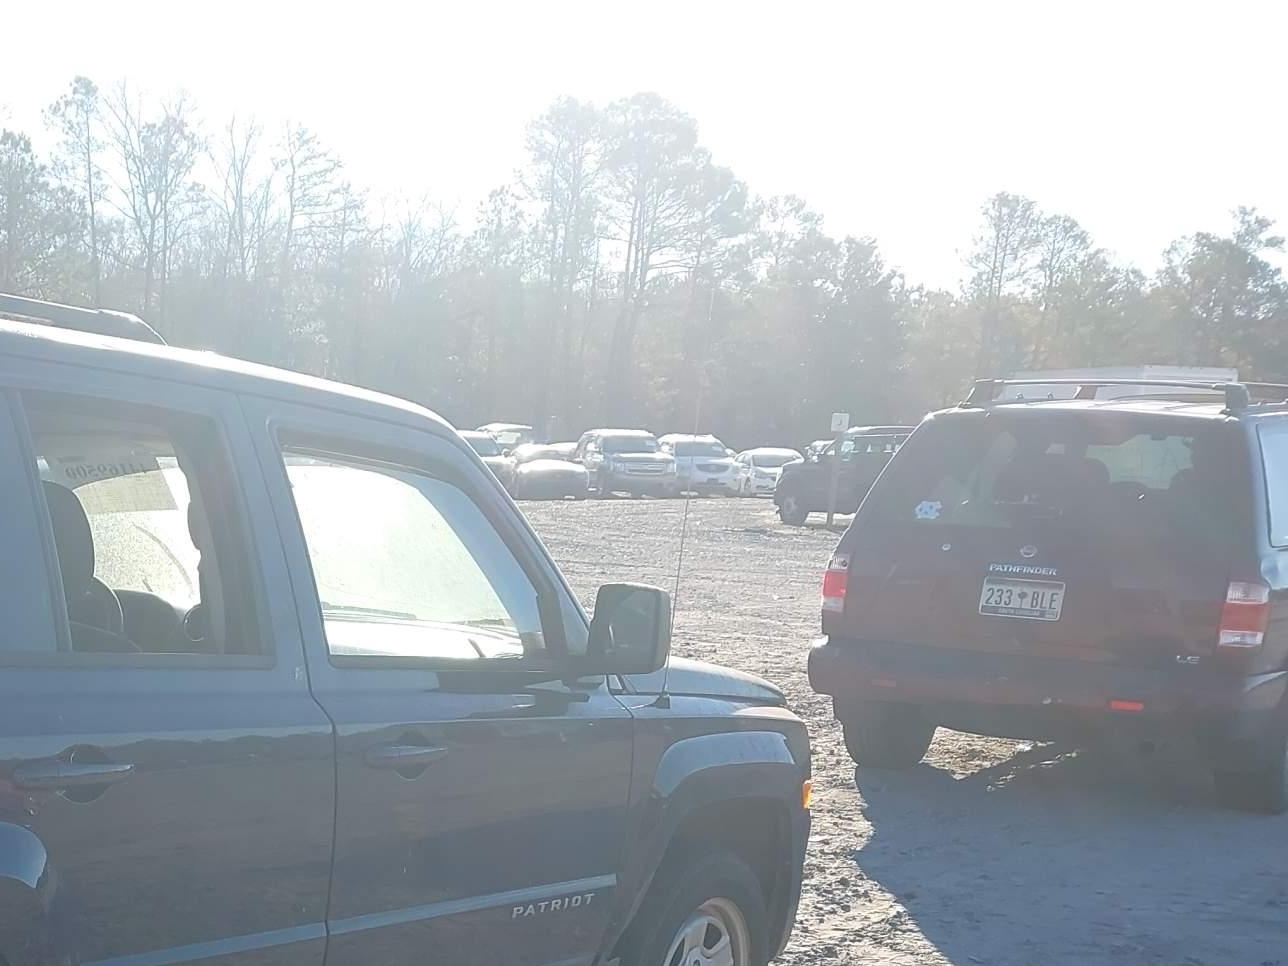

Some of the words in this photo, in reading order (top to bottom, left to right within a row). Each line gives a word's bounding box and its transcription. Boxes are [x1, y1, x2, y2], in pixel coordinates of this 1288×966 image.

[988, 563, 1058, 576] PATHFINDER
[985, 587, 1013, 607] 233
[1030, 590, 1059, 610] BLE
[1175, 655, 1201, 665] LE
[511, 893, 595, 919] PATRIOT
